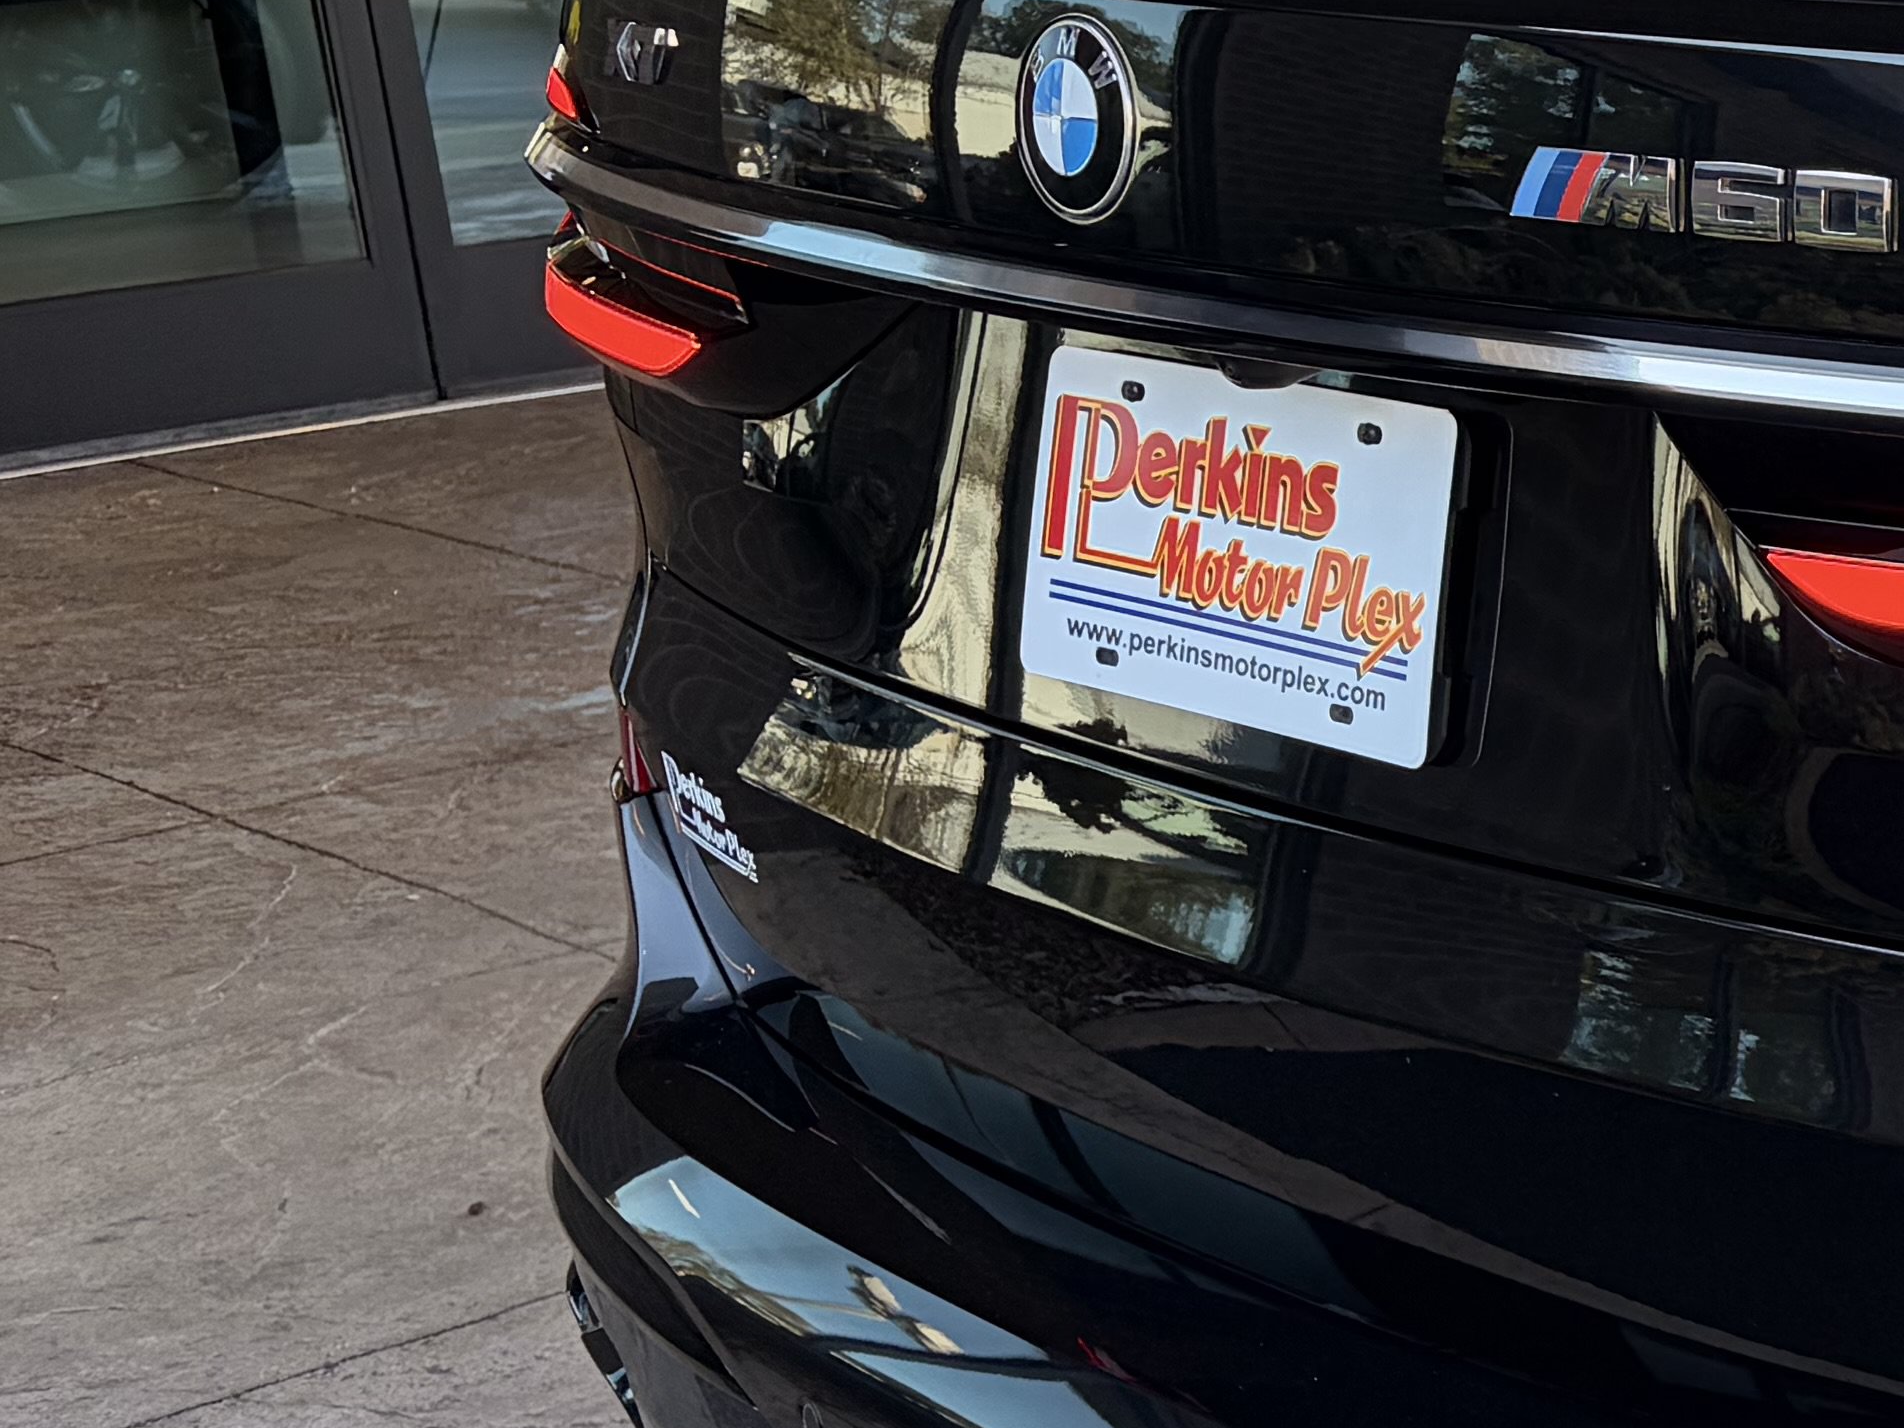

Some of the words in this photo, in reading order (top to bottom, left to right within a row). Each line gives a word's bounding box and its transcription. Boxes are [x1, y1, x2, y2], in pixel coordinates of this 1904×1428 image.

[1030, 25, 1118, 90] BMW
[1040, 393, 1341, 575] Perkins
[1066, 614, 1387, 712] www.perkinsmotorplex.com
[1155, 514, 1306, 621] Motor
[1302, 546, 1427, 680] Plex
